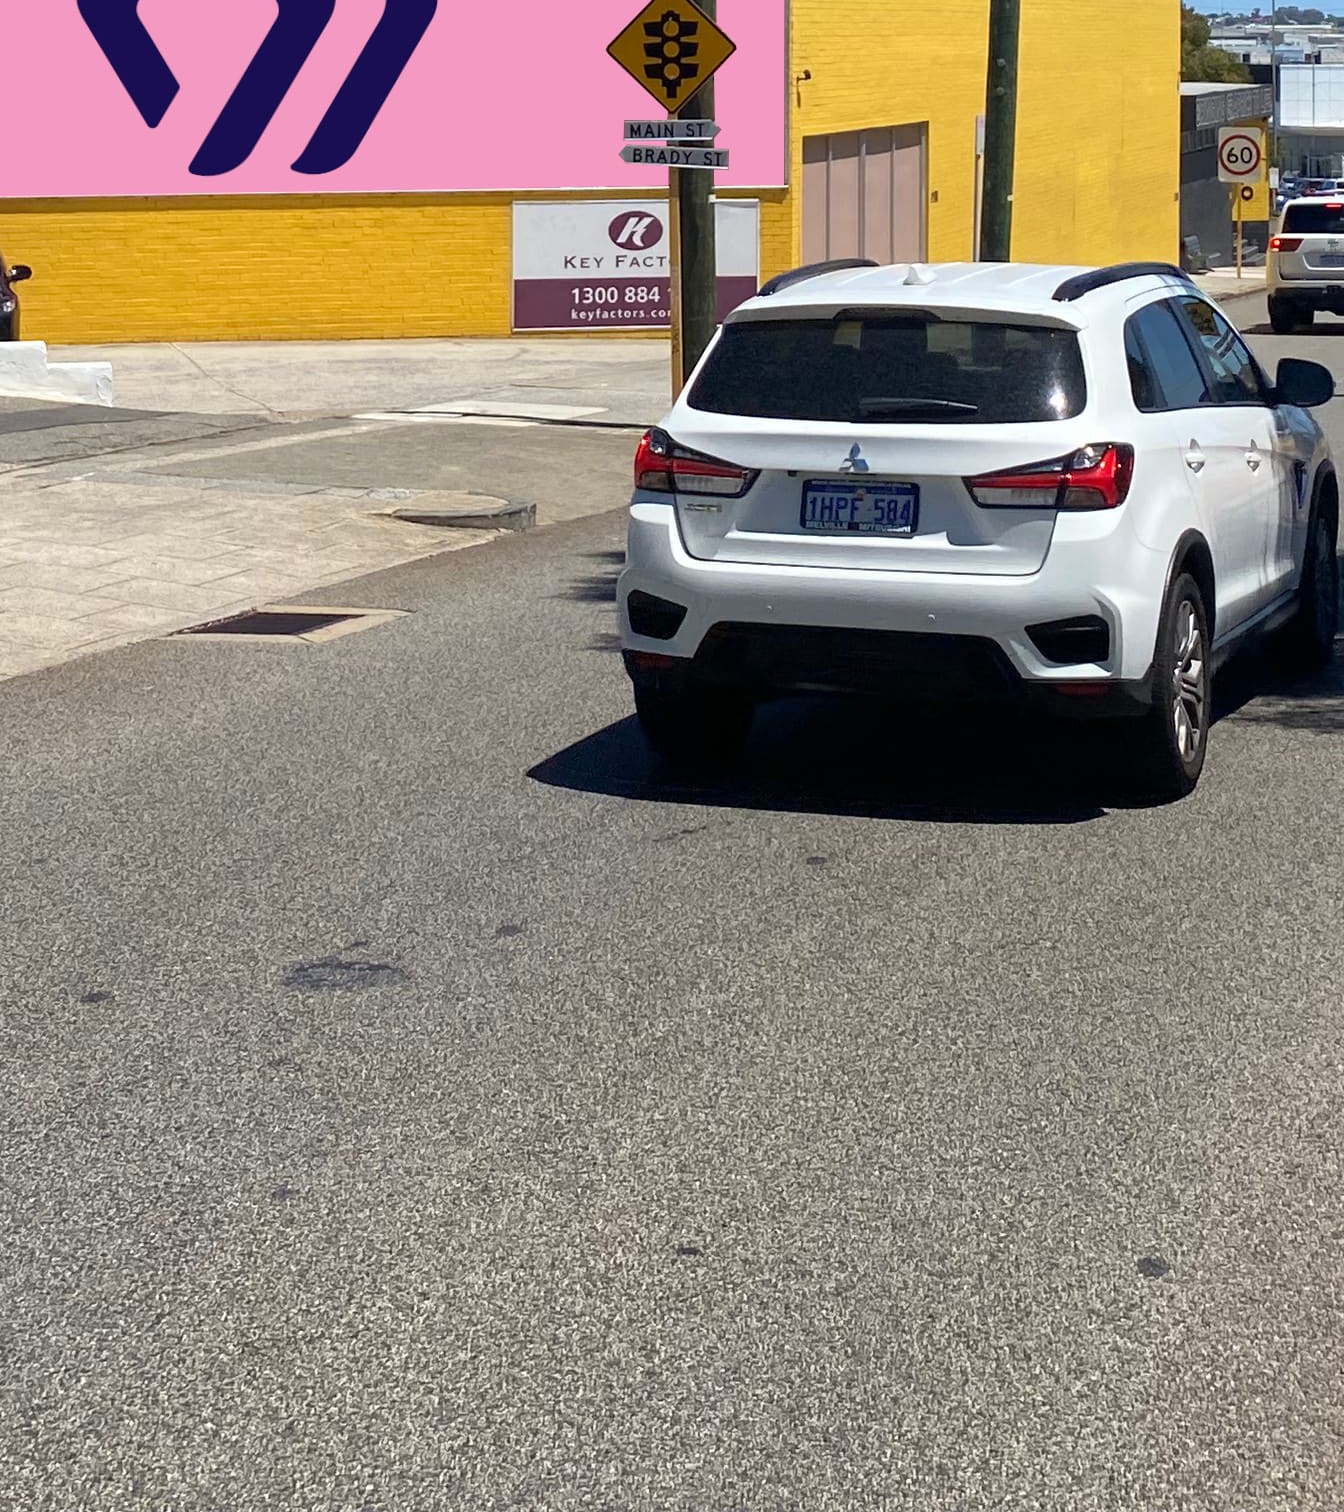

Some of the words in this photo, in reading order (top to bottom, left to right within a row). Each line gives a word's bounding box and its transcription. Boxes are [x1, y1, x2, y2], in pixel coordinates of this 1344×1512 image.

[630, 124, 674, 139] MAIN
[686, 123, 705, 138] ST
[633, 148, 692, 165] BRADY
[703, 152, 722, 167] ST
[1227, 146, 1253, 164] 60
[564, 255, 604, 269] KEY
[616, 254, 671, 268] FACT
[571, 287, 617, 304] 1300
[624, 286, 660, 303] 884
